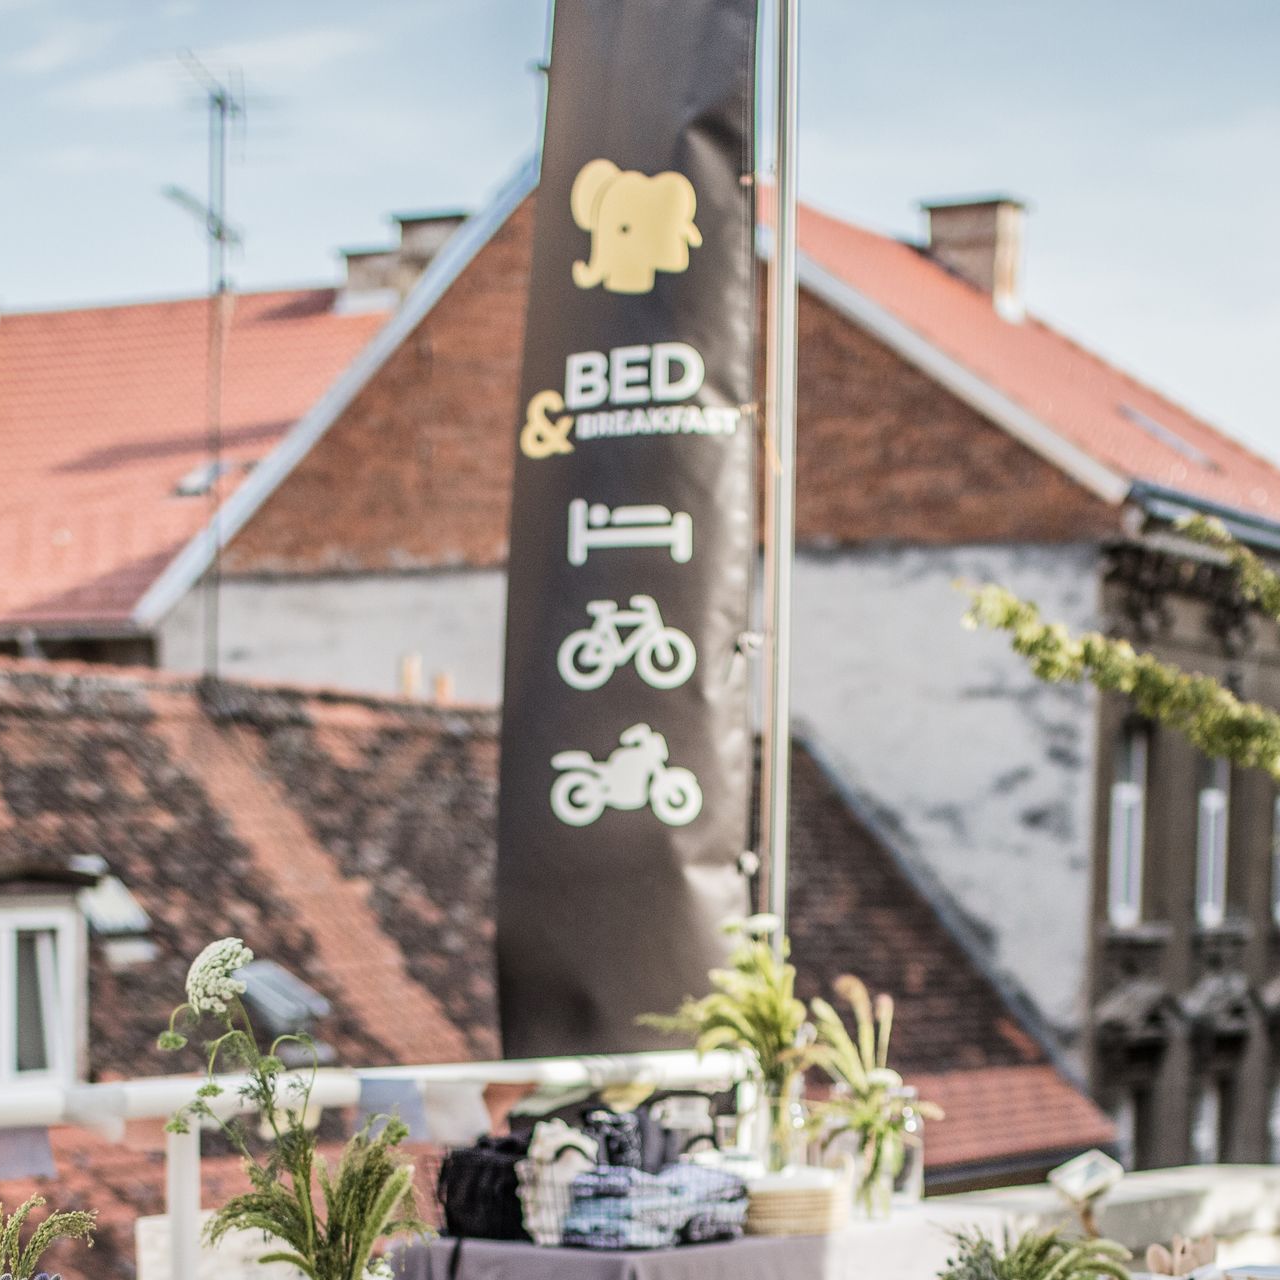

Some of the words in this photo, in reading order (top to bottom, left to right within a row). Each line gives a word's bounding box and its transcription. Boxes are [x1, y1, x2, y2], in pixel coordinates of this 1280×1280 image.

[565, 342, 705, 410] BED
[521, 390, 575, 459] &
[576, 405, 740, 440] BREAKFAST
